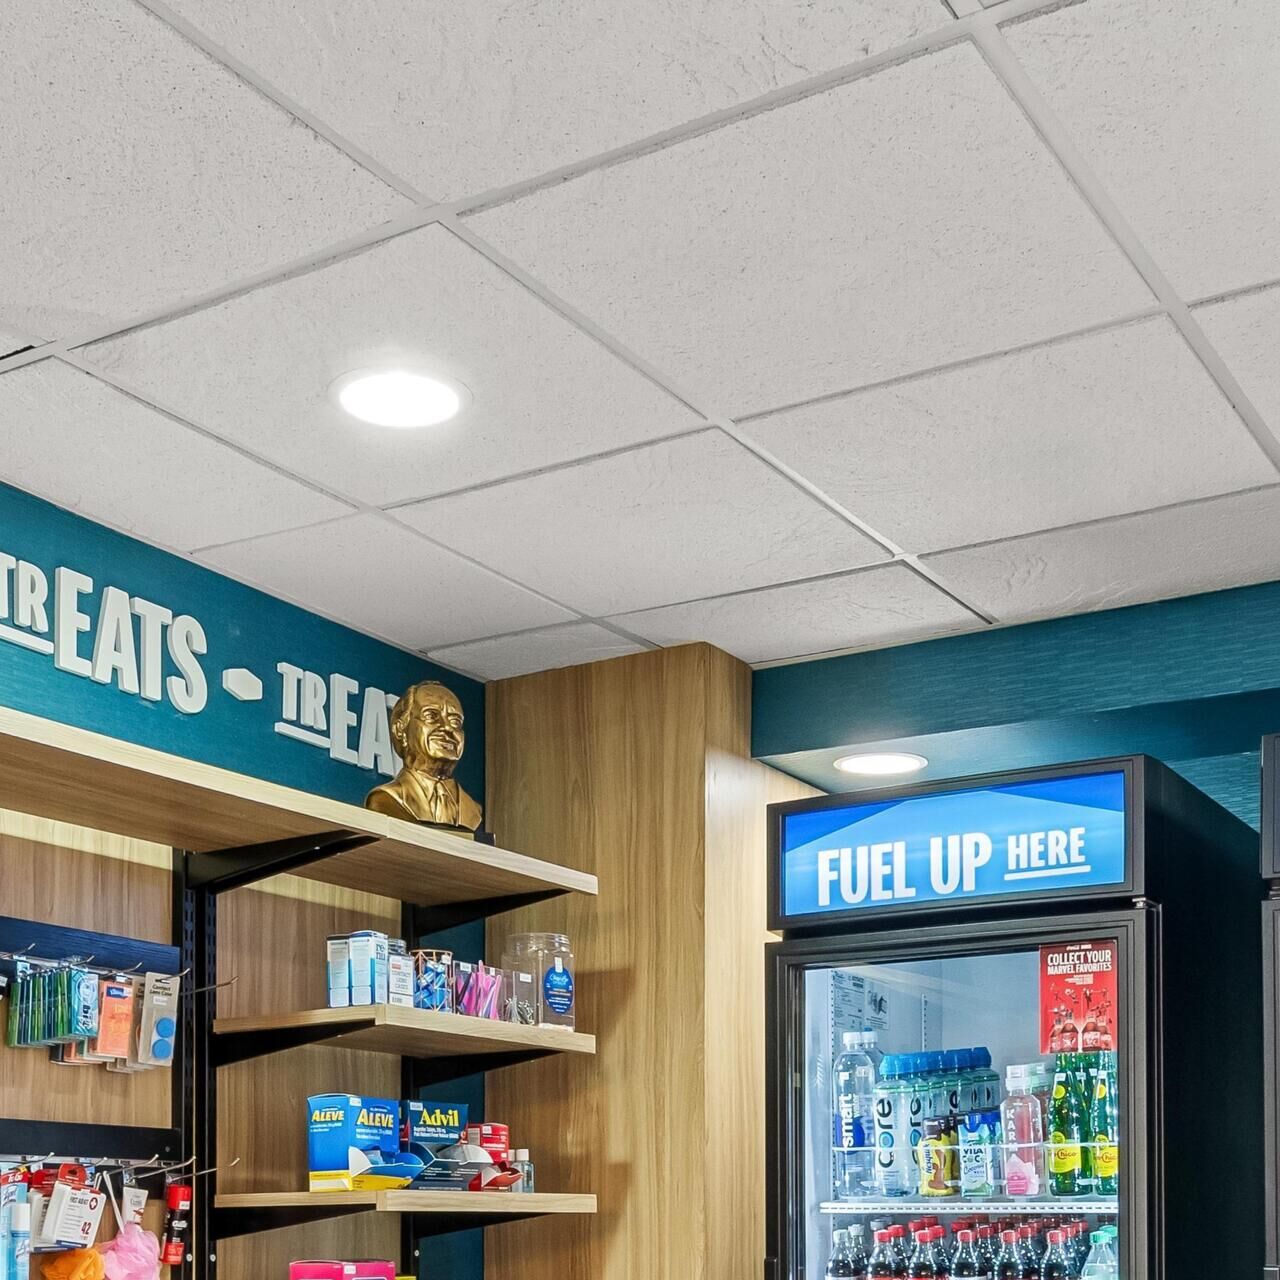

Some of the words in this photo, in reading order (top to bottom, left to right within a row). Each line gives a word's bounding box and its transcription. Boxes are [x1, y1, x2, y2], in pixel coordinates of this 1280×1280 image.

[277, 662, 405, 779] TREA
[817, 841, 916, 907] FUEL
[929, 832, 993, 895] UP
[1006, 826, 1087, 870] HERE
[1047, 952, 1086, 966] COLLECT
[1086, 950, 1112, 963] YOUR
[1047, 965, 1075, 975] MARVEL
[1075, 962, 1112, 973] FAVORITES
[311, 1109, 345, 1122] ALEVE
[356, 1108, 394, 1128] ALEVE
[419, 1108, 459, 1127] Advil
[839, 1093, 854, 1148] smart
[875, 1097, 895, 1168] core
[81, 1222, 92, 1235] 42
